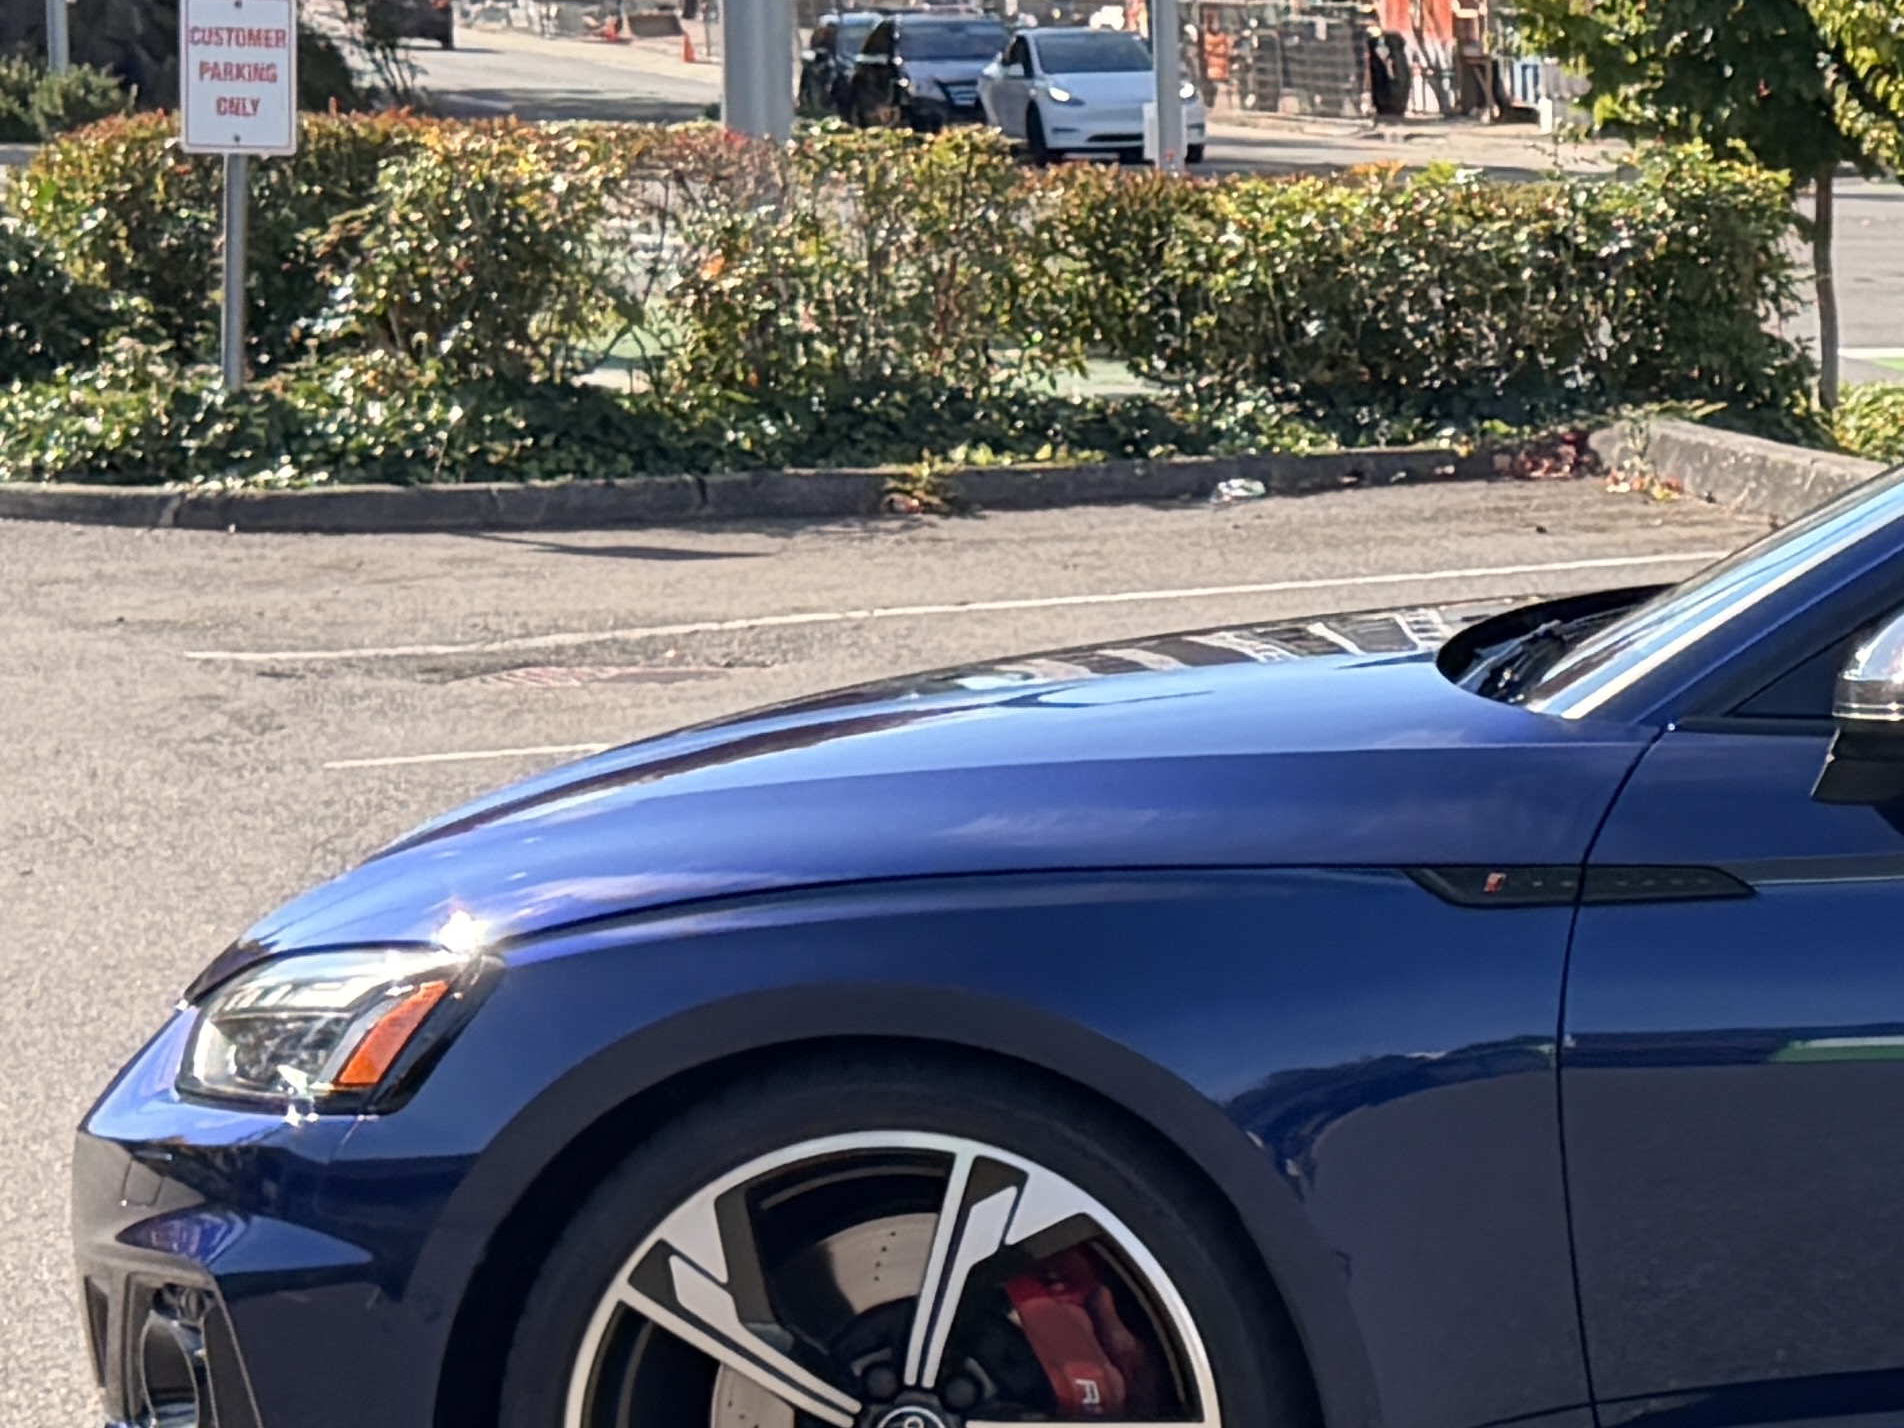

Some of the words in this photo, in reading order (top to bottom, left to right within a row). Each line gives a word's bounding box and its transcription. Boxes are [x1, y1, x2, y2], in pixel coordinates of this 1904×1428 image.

[188, 25, 288, 50] CUSTOMER
[199, 60, 279, 85] PARKING
[216, 95, 261, 118] ONLY
